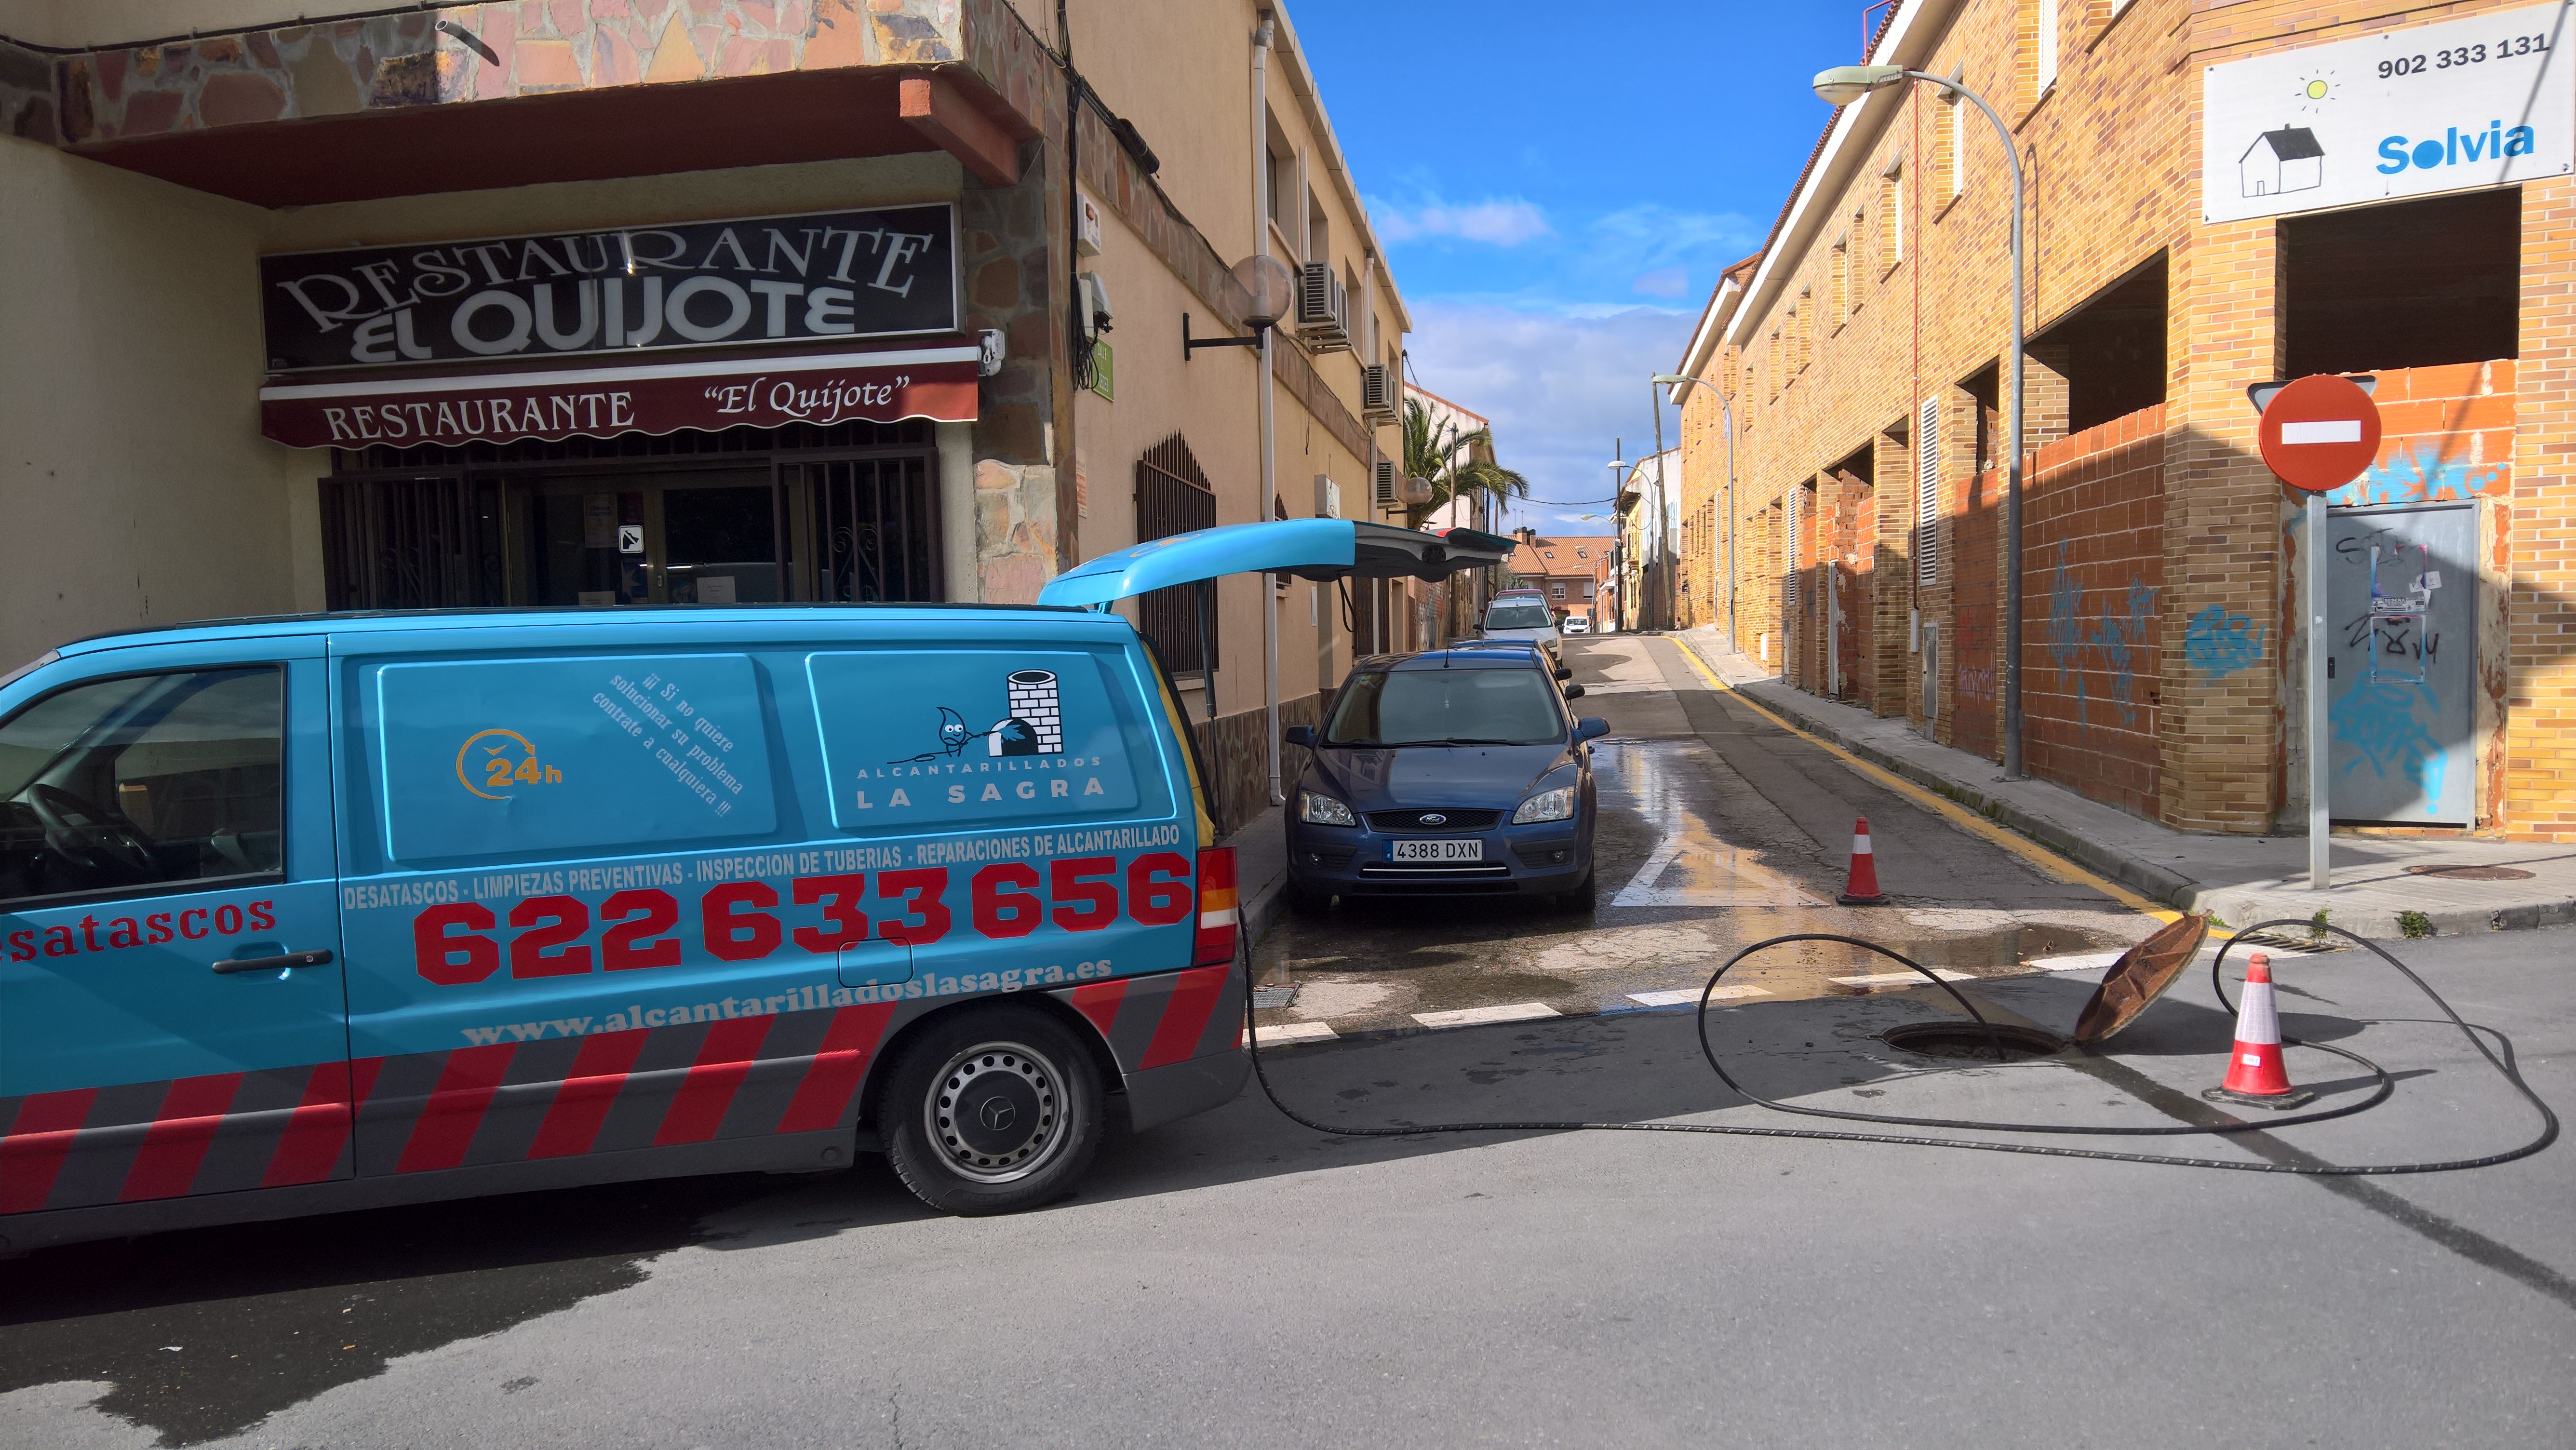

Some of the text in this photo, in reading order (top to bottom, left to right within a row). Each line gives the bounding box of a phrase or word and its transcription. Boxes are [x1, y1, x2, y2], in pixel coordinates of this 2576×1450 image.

[2377, 32, 2550, 80] 902 333 131
[2376, 119, 2535, 175] Solvia
[276, 226, 934, 334] RESTAURANTE
[350, 275, 855, 362] EL QUIJOTE
[322, 391, 635, 440] RESTAURANTE
[593, 692, 643, 737] contrate
[643, 737, 655, 749] a
[656, 748, 717, 804] cualquiera
[609, 674, 743, 794] solucionar su problema
[660, 683, 680, 701] Si
[676, 699, 694, 716] no
[694, 717, 734, 752] quiere
[485, 757, 562, 787] 24h
[857, 756, 1102, 779] ALCANTARILLADOS
[857, 777, 1104, 809] LA SAGRA
[344, 880, 458, 910] DESATASCOS
[473, 871, 564, 900] LIMPIEZAS
[569, 863, 683, 892] PREVENTIVAS
[697, 854, 795, 883] INSPECCION
[799, 852, 819, 873] DE
[824, 846, 902, 873] TUBERIAS
[918, 838, 1030, 866] REPARACIONES
[1034, 834, 1053, 856] DE
[1057, 824, 1180, 853] ALCANTARILLADO
[1396, 843, 1439, 858] 4388
[1446, 843, 1478, 858] DXN
[0, 900, 276, 963] satascos
[460, 959, 1112, 1047] www.alcantarilladoslasagra.es
